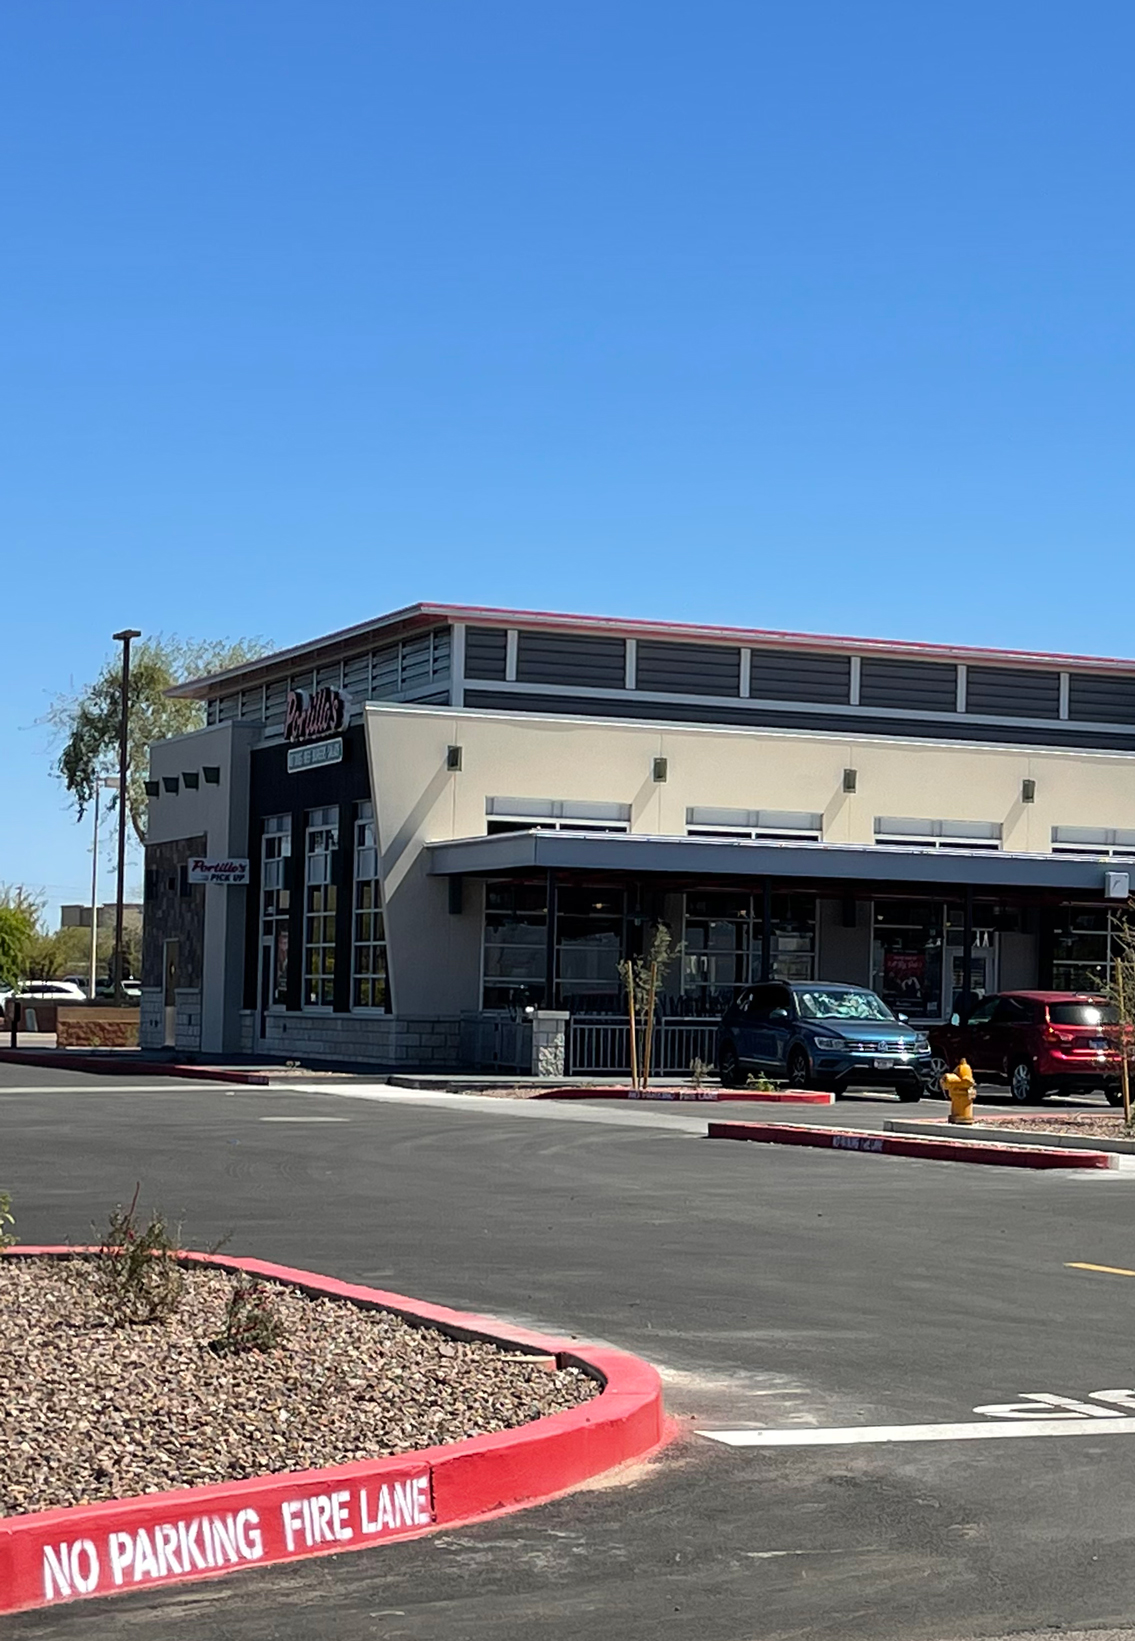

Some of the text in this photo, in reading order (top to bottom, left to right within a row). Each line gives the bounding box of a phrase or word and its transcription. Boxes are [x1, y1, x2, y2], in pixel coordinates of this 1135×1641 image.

[284, 687, 346, 740] Portillo's
[191, 860, 247, 872] Portillo's
[210, 873, 230, 881] PICK
[43, 1475, 431, 1600] NO PARKING FIRE LANE
